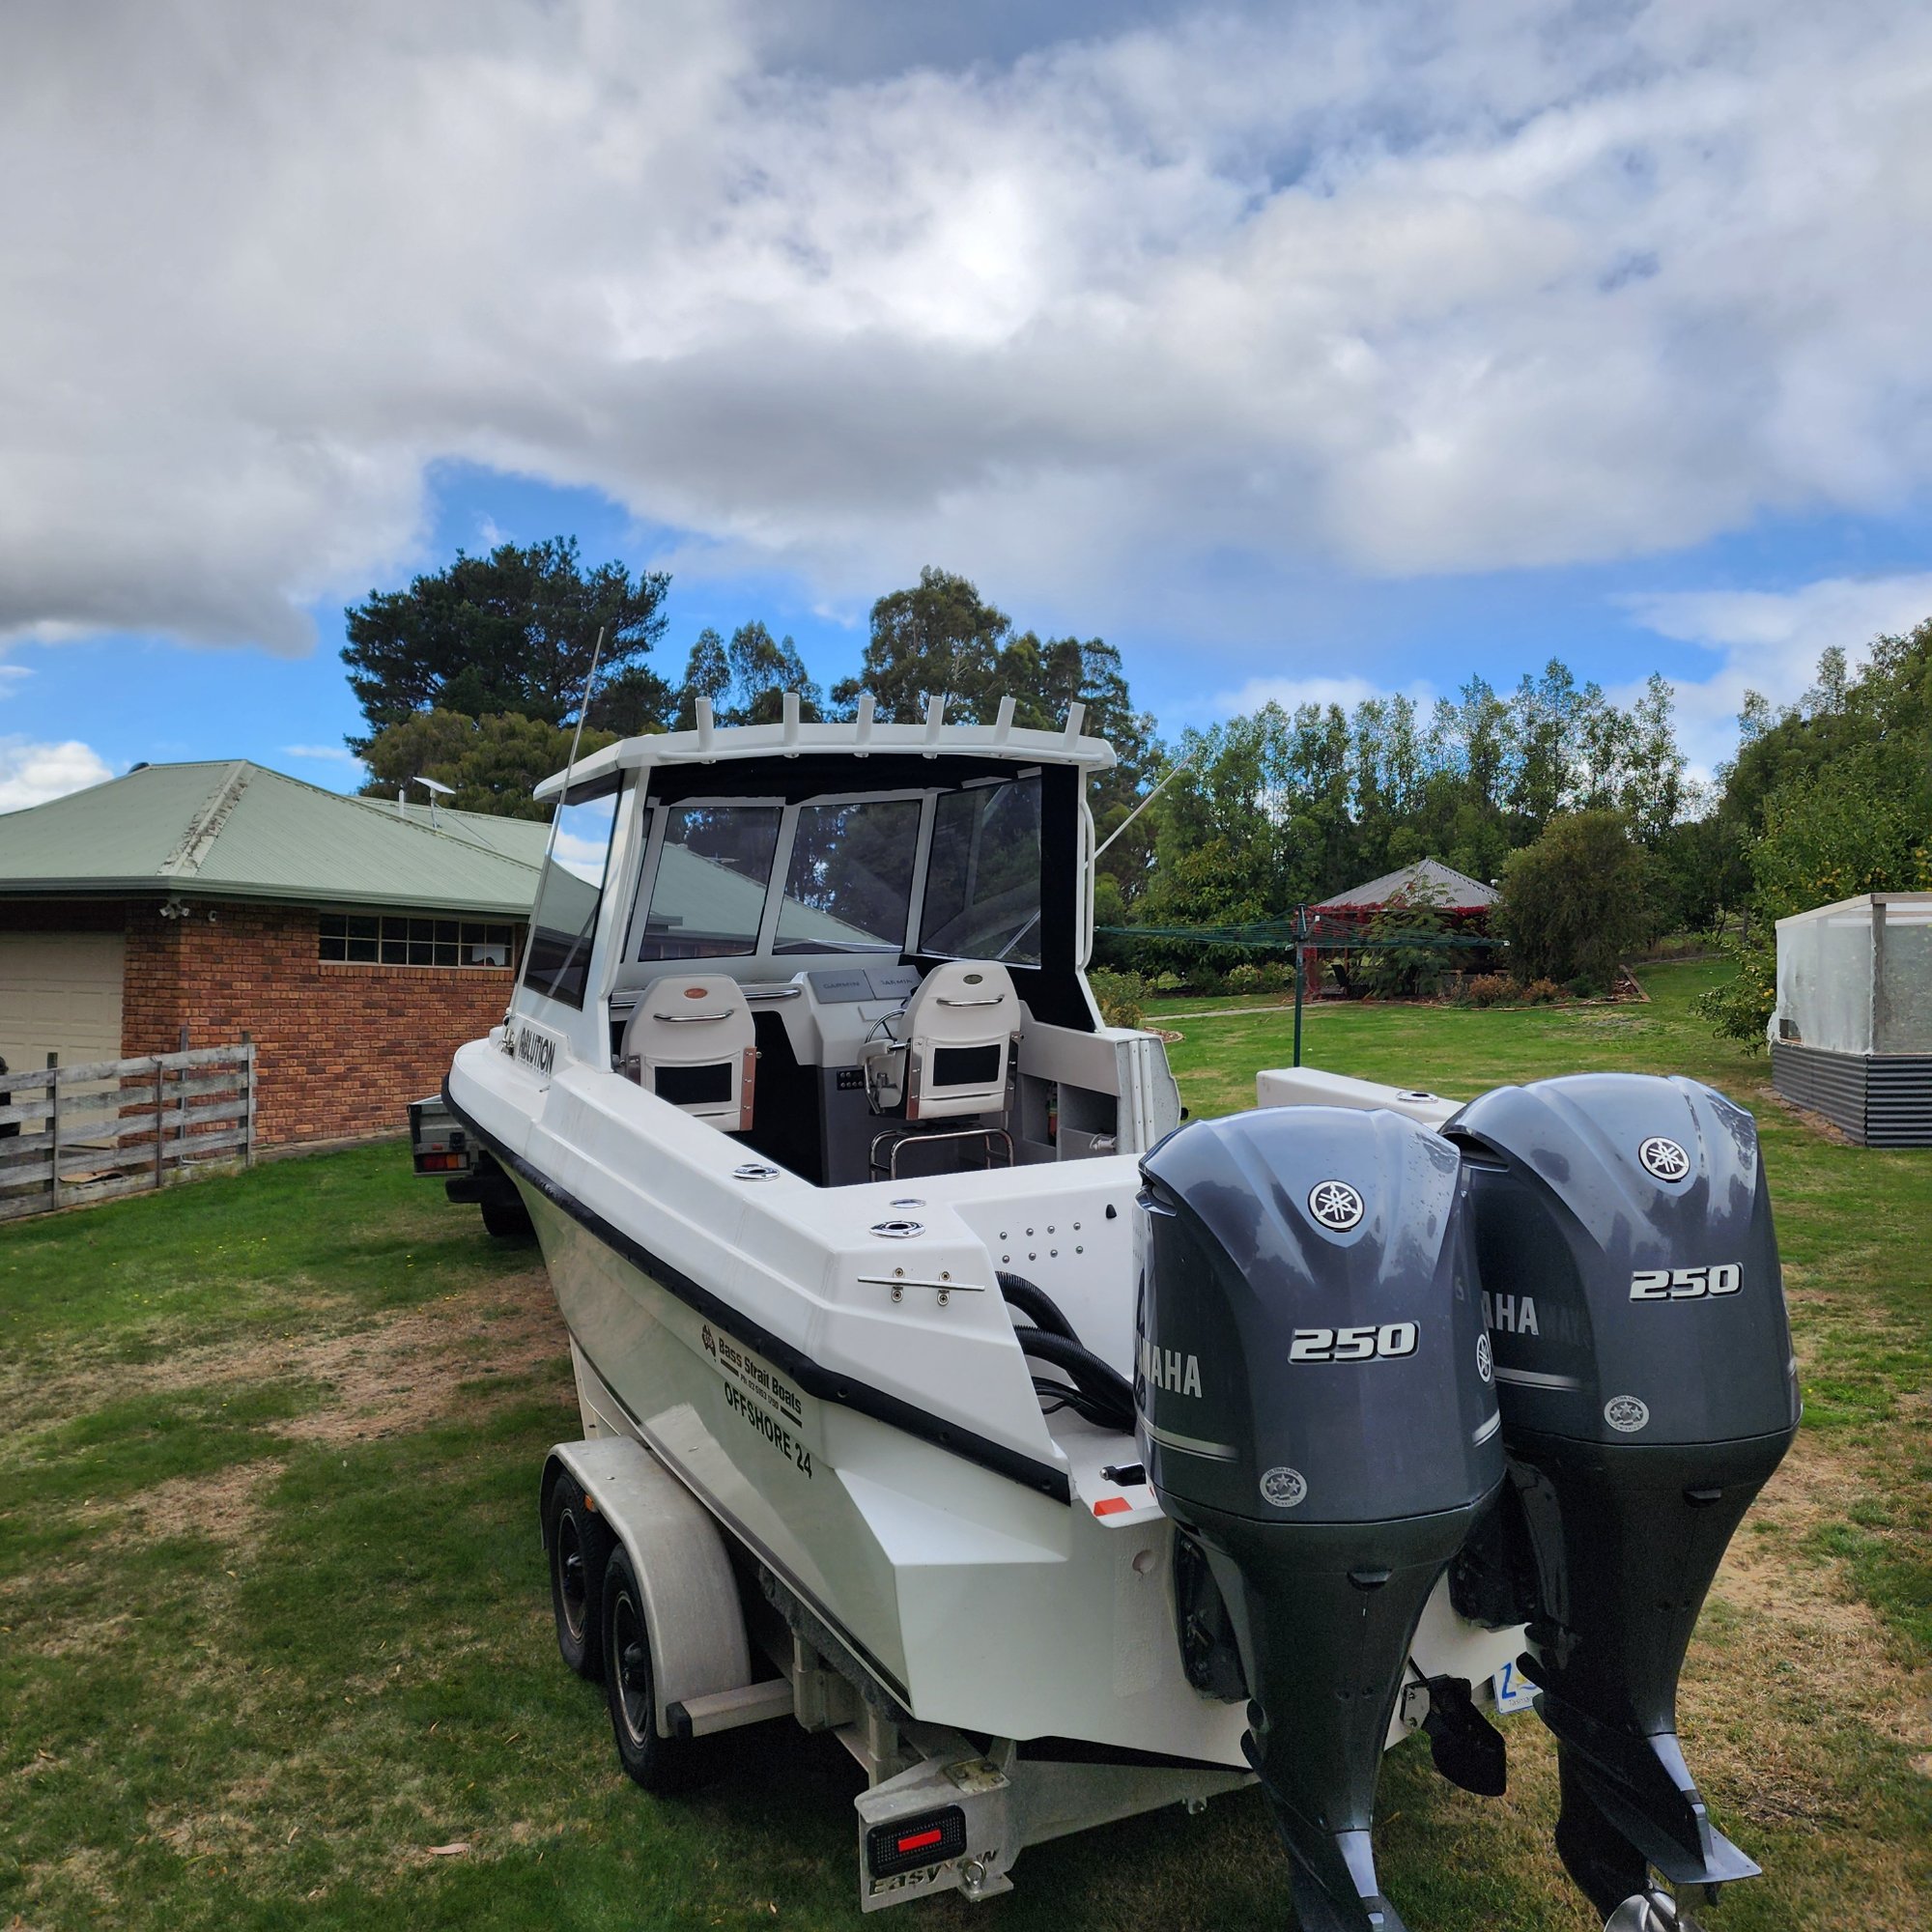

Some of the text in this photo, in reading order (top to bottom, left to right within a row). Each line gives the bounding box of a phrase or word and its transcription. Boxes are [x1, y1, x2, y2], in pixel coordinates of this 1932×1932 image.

[1629, 1263, 1743, 1301] 250
[1289, 1321, 1419, 1363] 250
[719, 1337, 743, 1368] Bass
[744, 1356, 770, 1390] Strait
[772, 1376, 802, 1415] Boats
[724, 1381, 812, 1480] OFFSHORE 24
